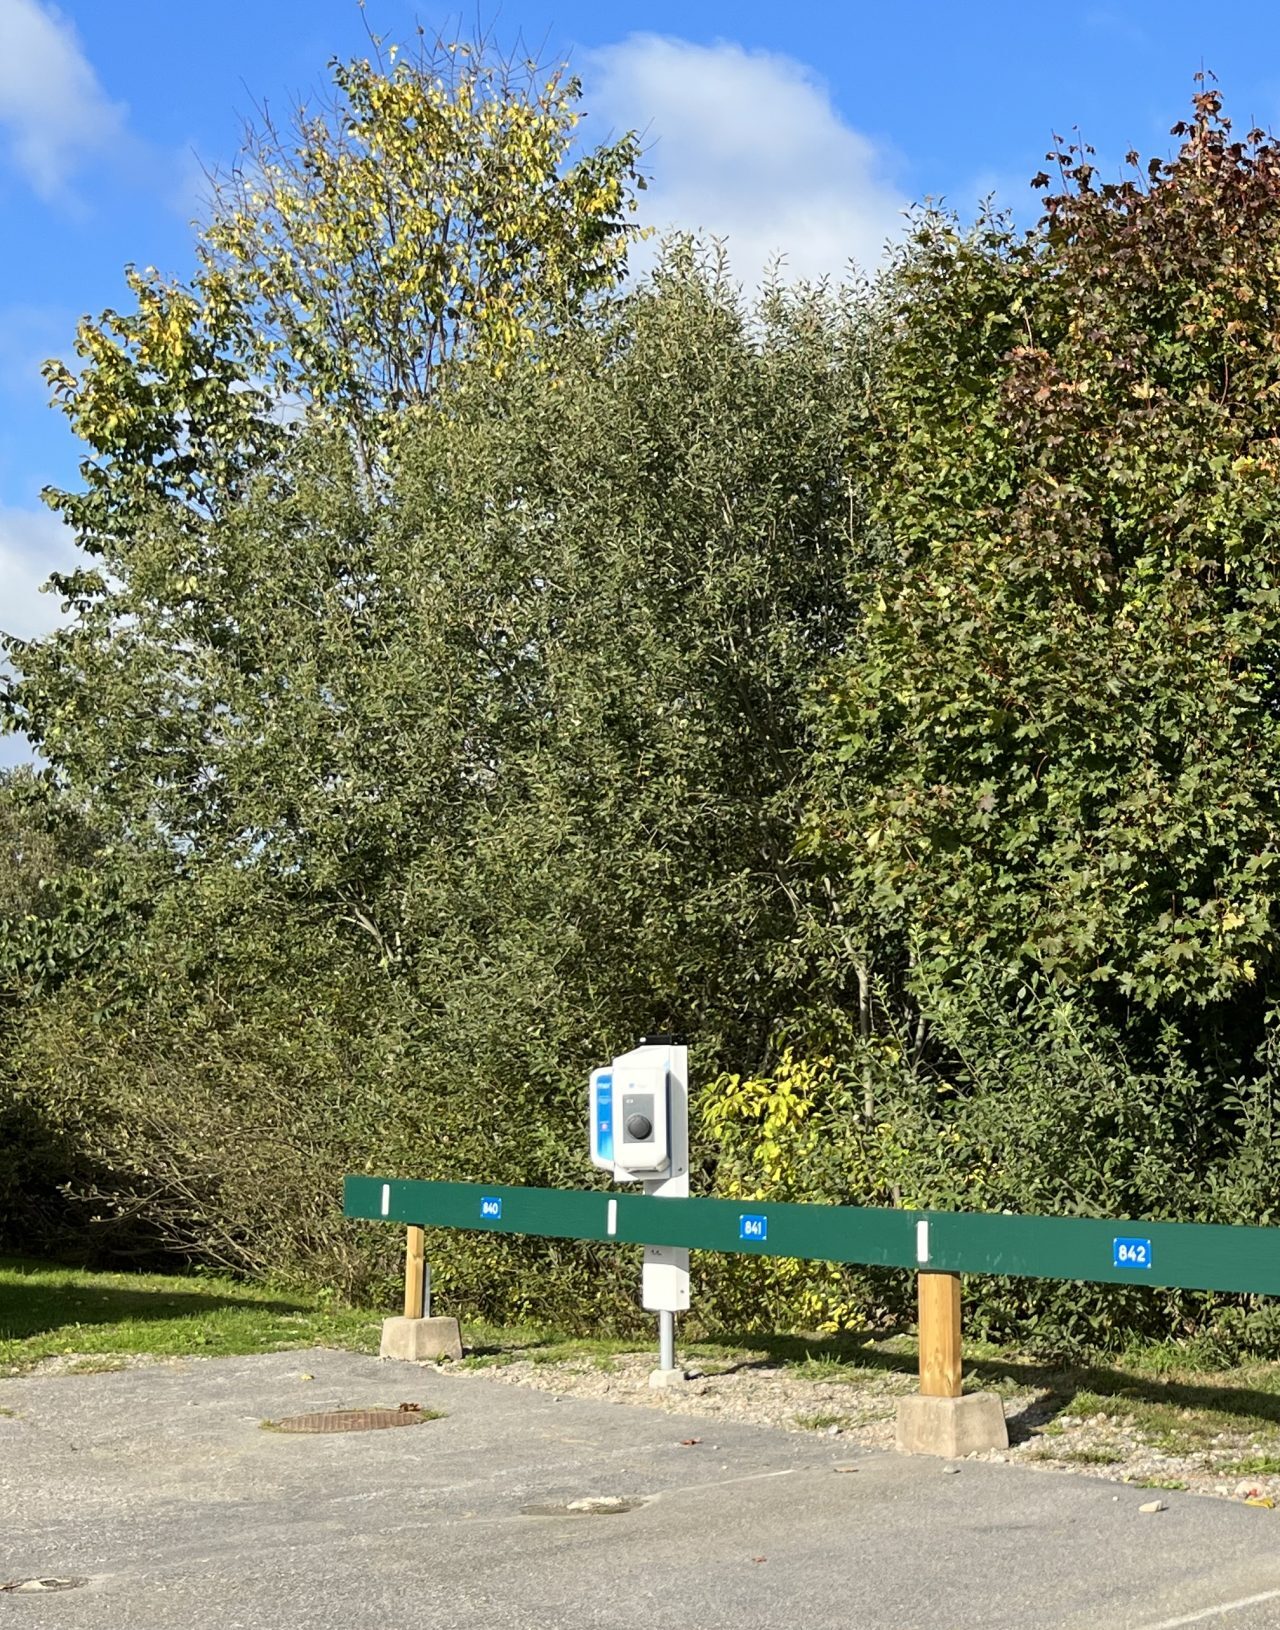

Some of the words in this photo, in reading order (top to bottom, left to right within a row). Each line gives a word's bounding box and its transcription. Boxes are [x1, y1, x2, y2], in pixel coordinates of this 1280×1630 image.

[483, 1201, 499, 1215] 840
[745, 1220, 762, 1235] 841
[1118, 1244, 1146, 1262] 842
